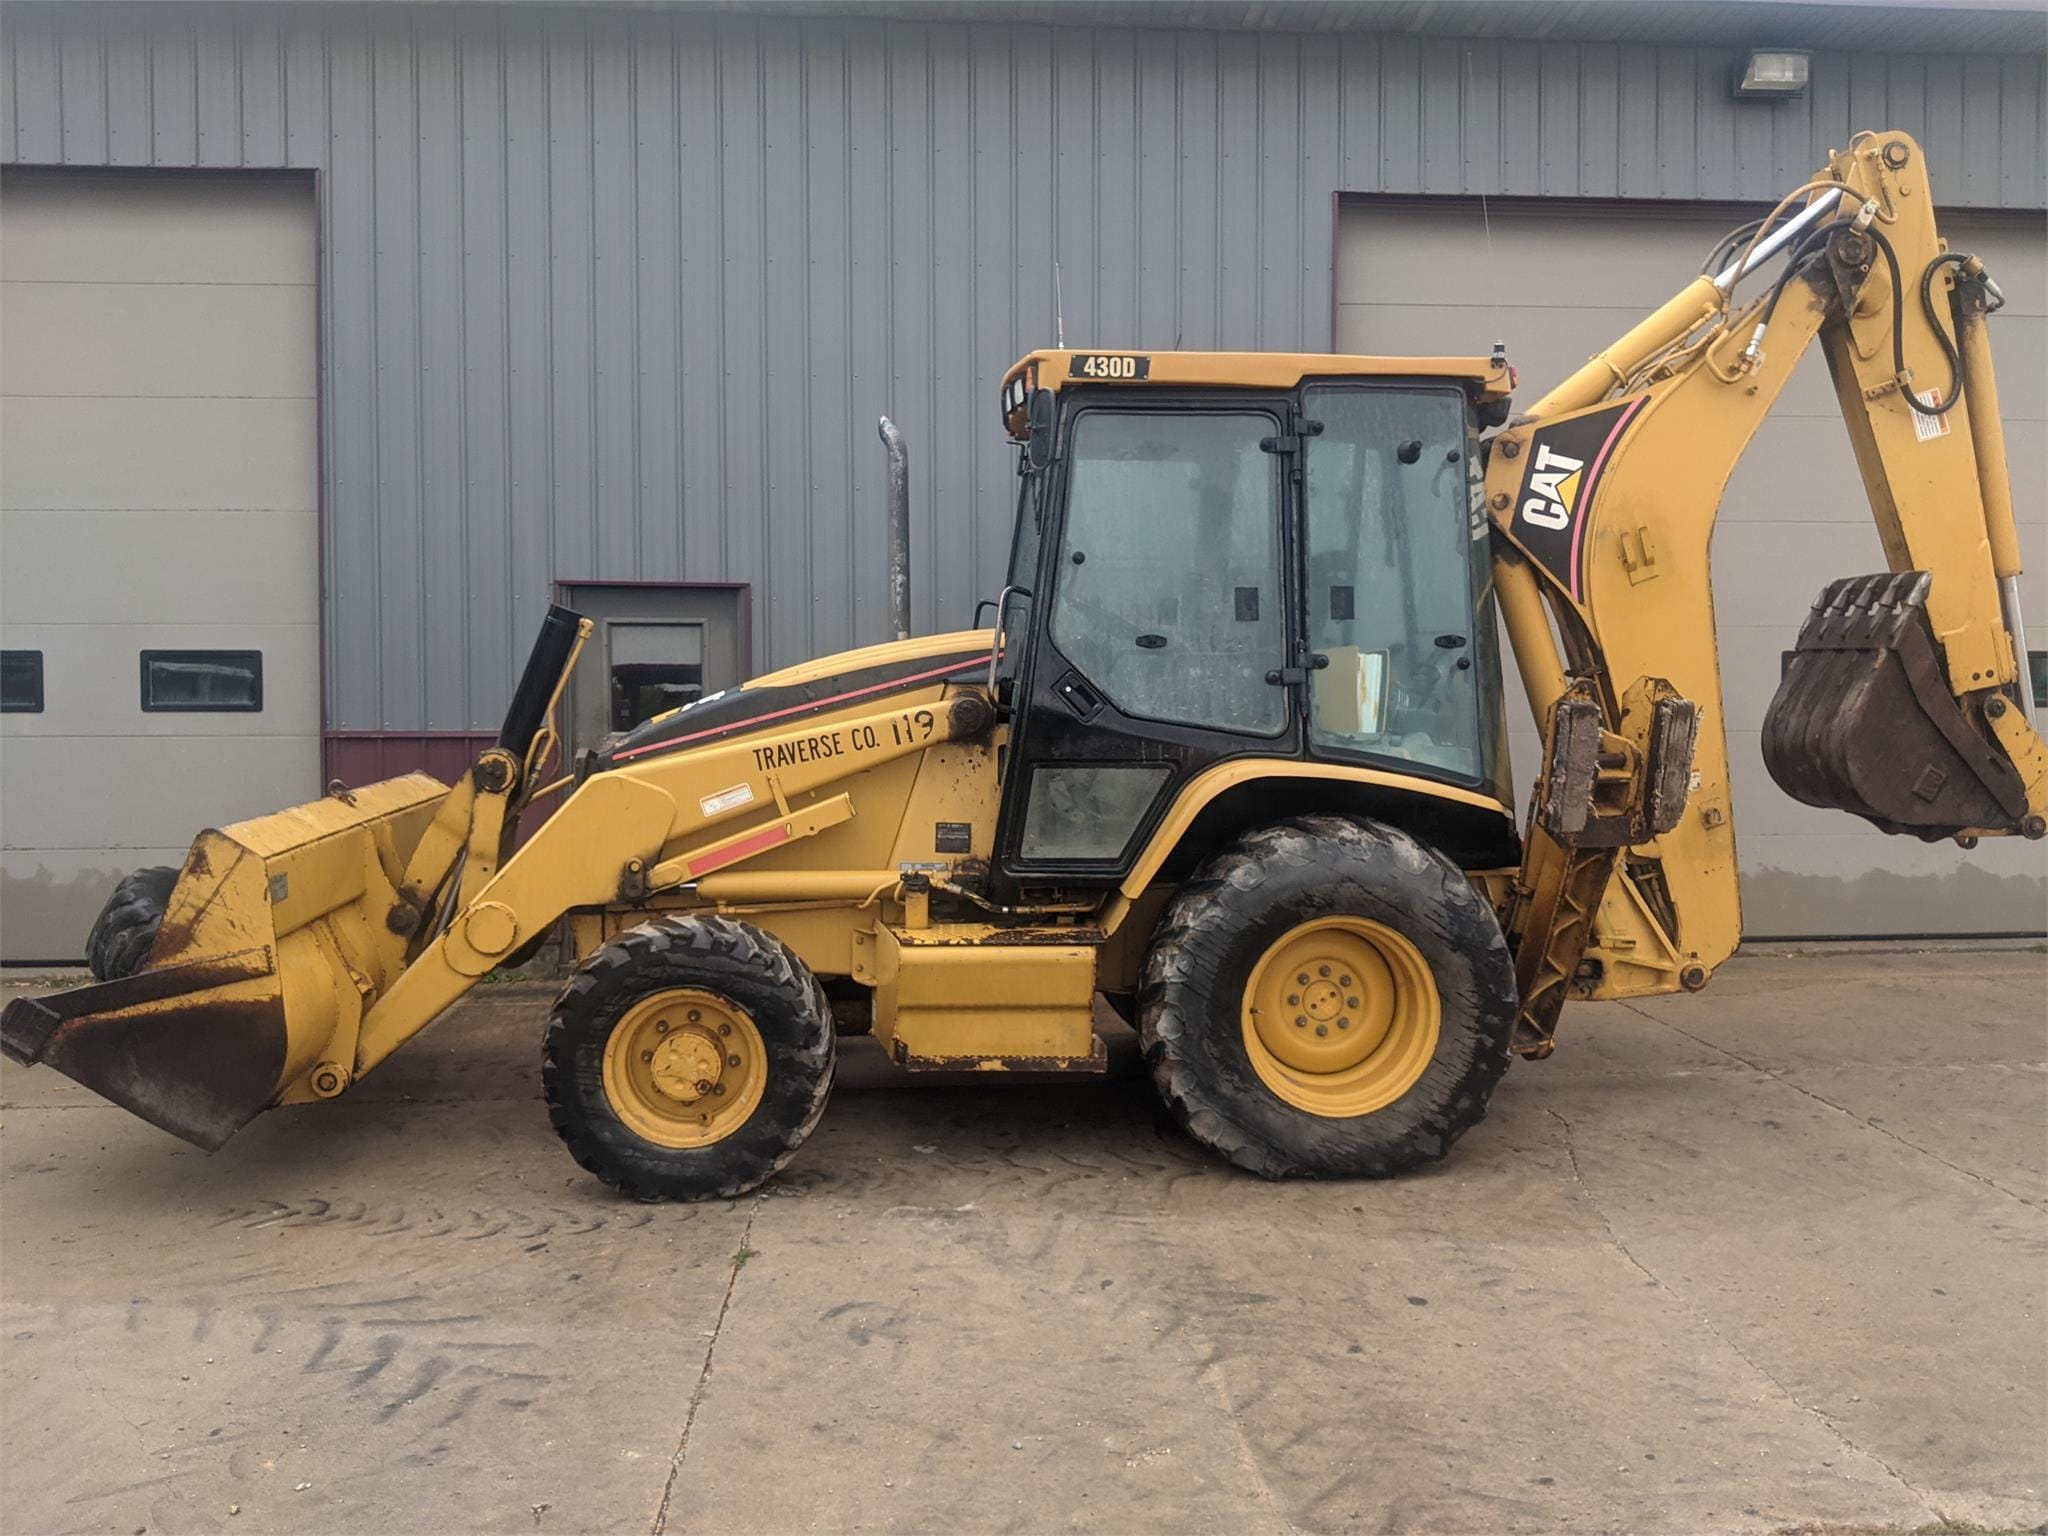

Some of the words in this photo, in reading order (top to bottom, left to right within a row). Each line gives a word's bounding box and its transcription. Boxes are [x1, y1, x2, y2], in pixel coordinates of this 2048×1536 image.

[1083, 356, 1136, 378] 430D
[1522, 442, 1585, 531] CAT
[752, 733, 843, 771] TRAVERSE
[851, 725, 881, 752] CO.
[892, 709, 935, 746] 119
